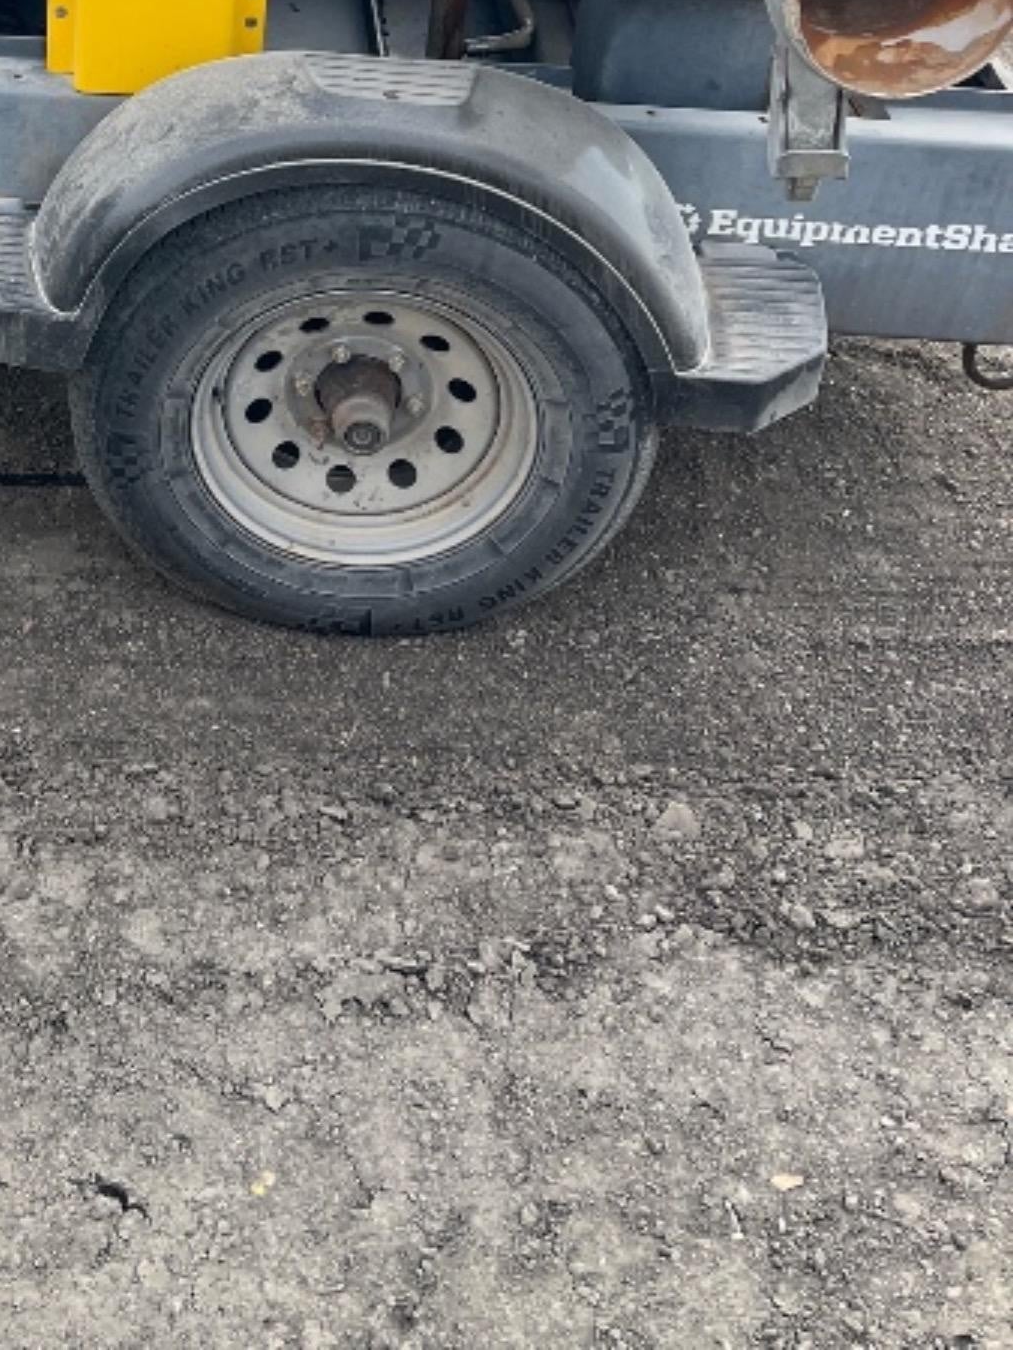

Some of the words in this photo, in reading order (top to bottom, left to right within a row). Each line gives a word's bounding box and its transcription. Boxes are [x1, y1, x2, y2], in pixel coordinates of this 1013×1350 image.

[181, 262, 246, 315] KING
[543, 469, 616, 566] TRAILER
[478, 555, 544, 610] KING
